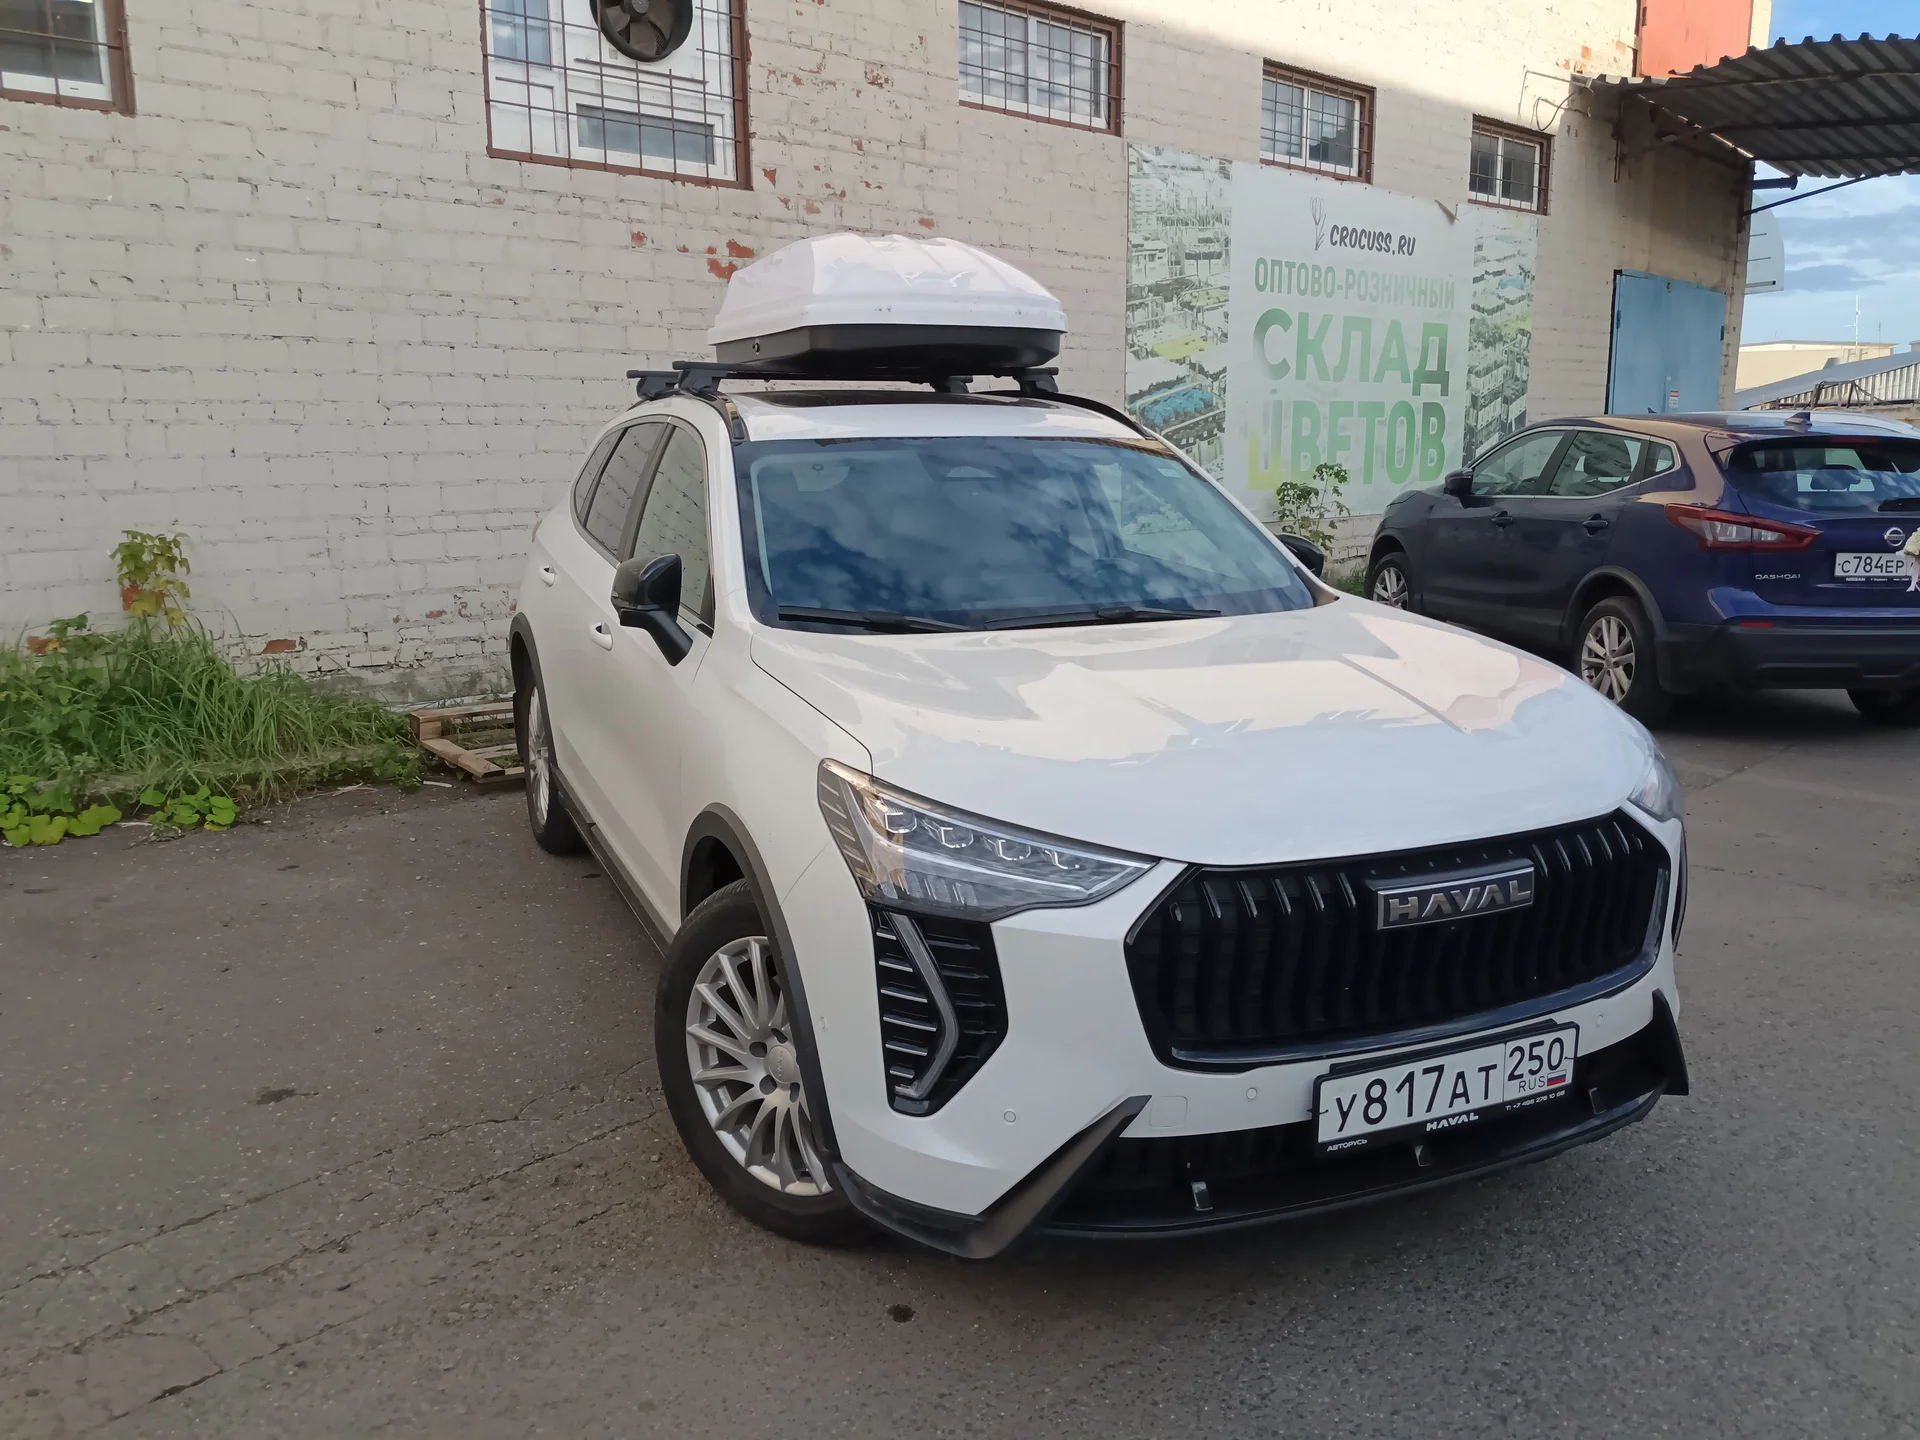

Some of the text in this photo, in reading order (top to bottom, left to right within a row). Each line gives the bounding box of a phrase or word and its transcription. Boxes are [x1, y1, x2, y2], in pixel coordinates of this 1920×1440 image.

[1330, 224, 1416, 257] CROCUSS.RU
[1254, 256, 1456, 311] ОПТОВО-РОЗНИЧНЫЙ
[1253, 307, 1450, 397] СКЛАД
[1754, 573, 1801, 581] QASHQAI
[1388, 880, 1531, 922] HAVAL
[1334, 1036, 1565, 1133] У817АТ 250
[1518, 1074, 1546, 1093] RUS
[1426, 1112, 1479, 1132] HAVAL
[1326, 1138, 1368, 1152] АВТОРУСЬ
